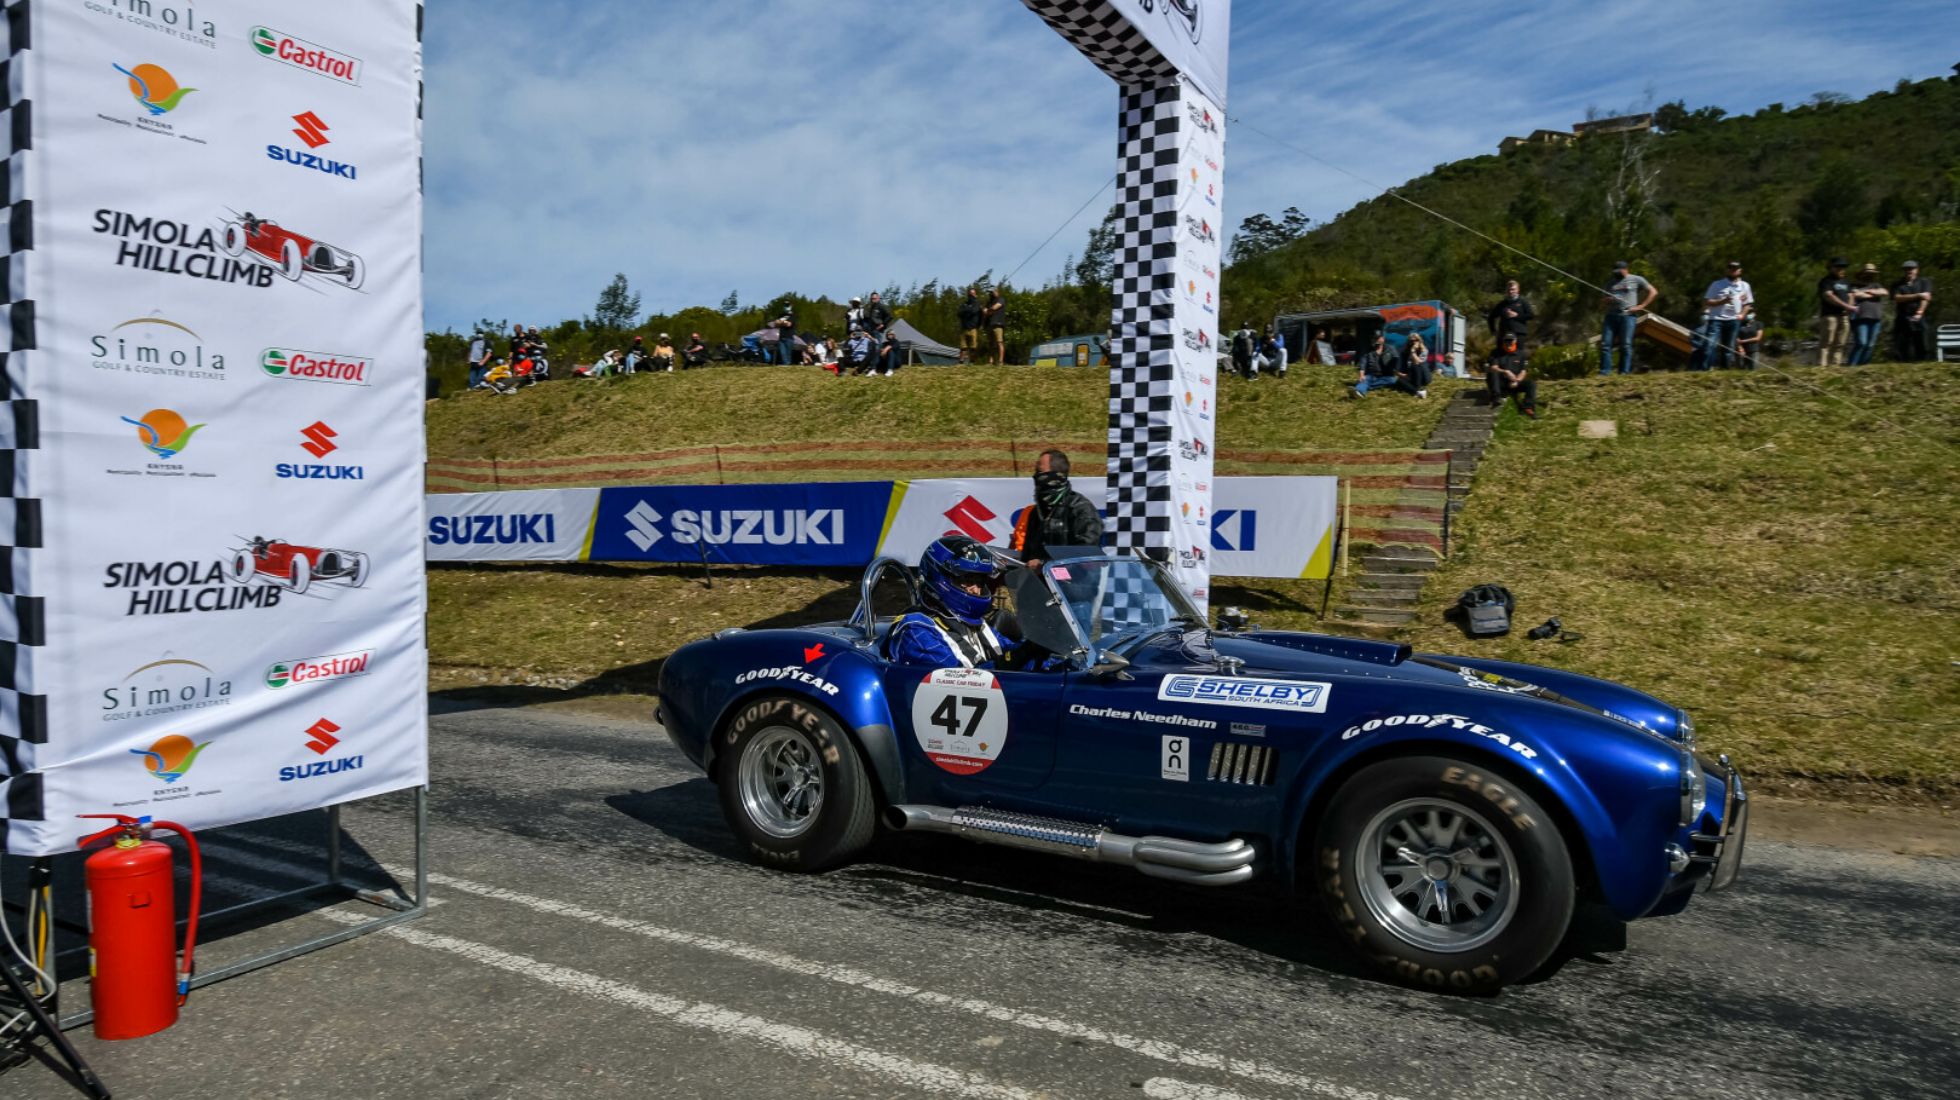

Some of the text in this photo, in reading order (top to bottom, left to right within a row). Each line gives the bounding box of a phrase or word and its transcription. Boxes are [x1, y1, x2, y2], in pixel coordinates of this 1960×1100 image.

[278, 37, 356, 82] Castrol
[267, 144, 357, 180] SUZUKI
[92, 208, 215, 253] SIMOLA
[115, 240, 275, 289] HILLCLIMB
[91, 335, 226, 371] Simola
[288, 353, 366, 382] Castrol
[134, 364, 186, 377] COUNTRY
[188, 369, 225, 381] ESTATE
[275, 462, 364, 481] SUZUKI
[427, 513, 555, 545] SUZUKI
[670, 508, 845, 545] SUZUKI
[103, 560, 226, 589] SIMOLA
[126, 585, 282, 617] HILLCLIMB
[291, 652, 369, 683] Castrol
[735, 664, 840, 696] GOODYEAR
[102, 677, 232, 710] Simola
[1197, 681, 1314, 701] SHELBY
[1228, 695, 1300, 707] SOUTH AFRICA
[144, 703, 193, 716] COUNTRY
[930, 694, 988, 738] 47
[1069, 703, 1218, 730] Charles Needham
[1341, 712, 1539, 760] GOODYEAR
[279, 754, 364, 782] SUZUKI
[1442, 765, 1538, 832] EAGLE
